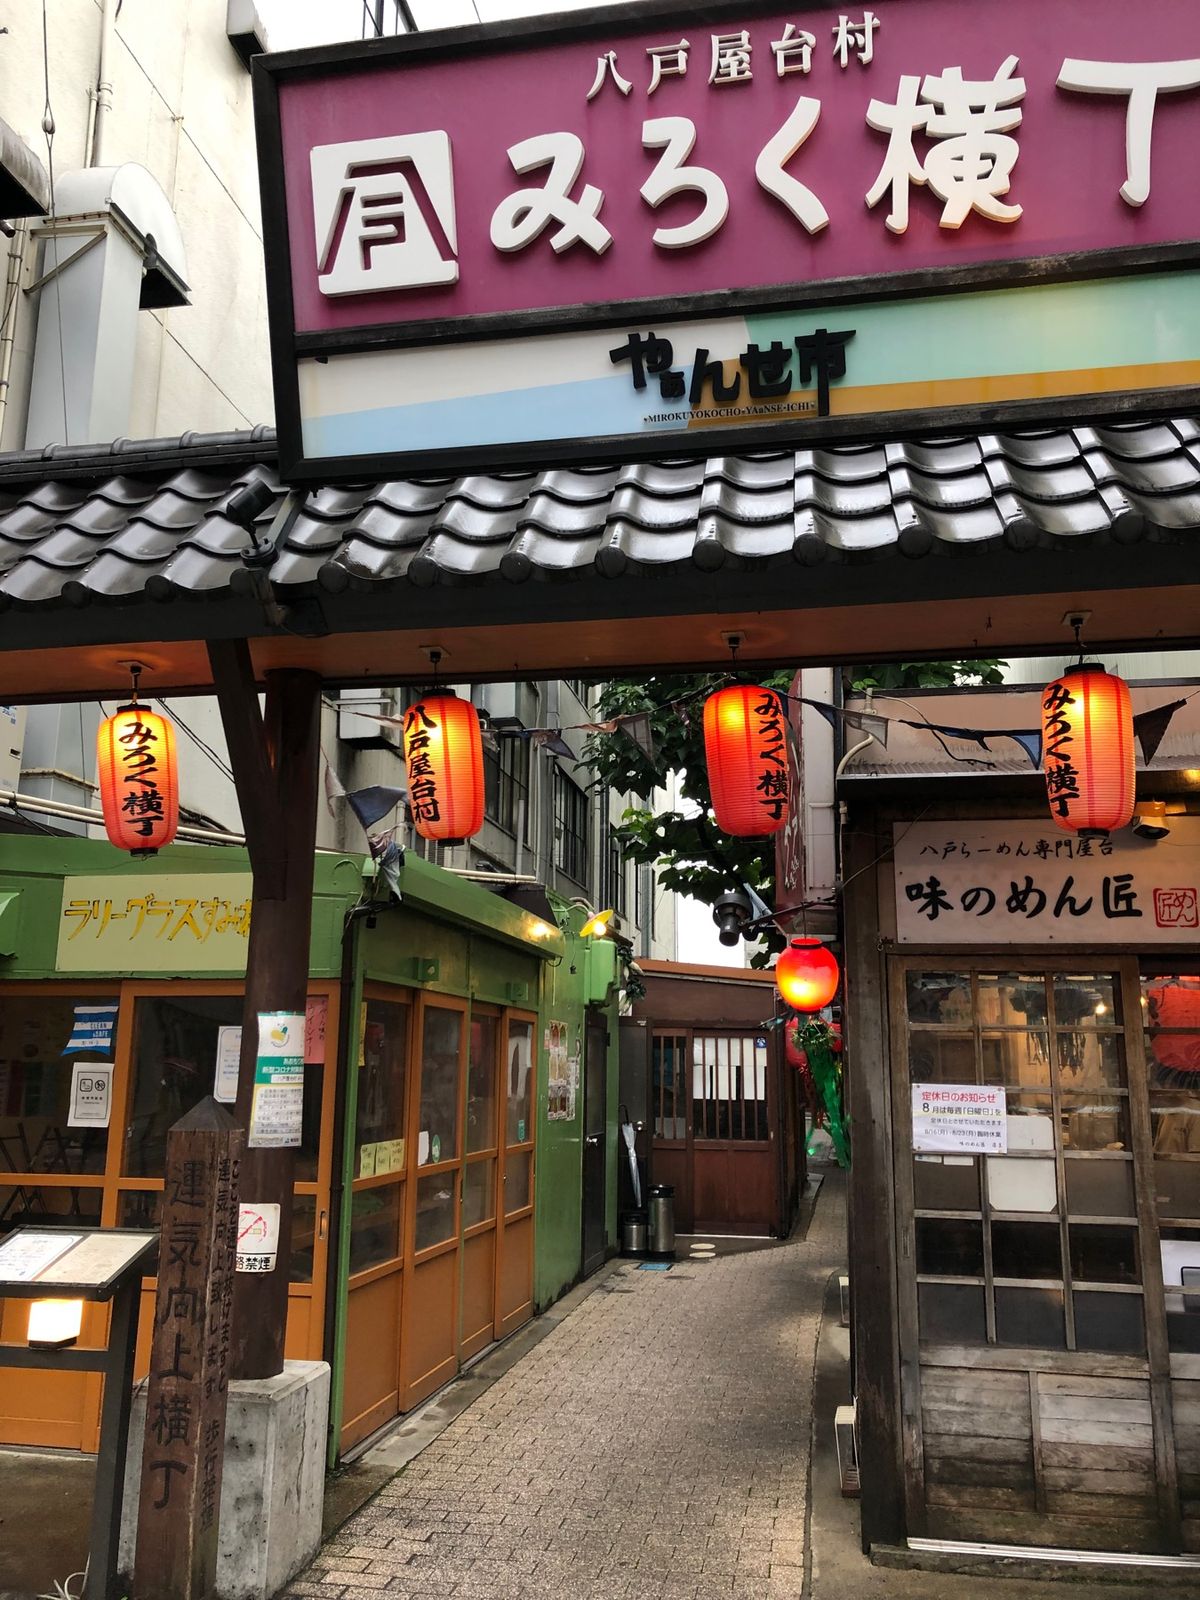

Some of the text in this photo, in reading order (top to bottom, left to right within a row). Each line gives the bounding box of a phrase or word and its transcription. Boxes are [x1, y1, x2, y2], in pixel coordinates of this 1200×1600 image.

[586, 11, 881, 101] 八戸屋台村
[490, 54, 1200, 255] みろく横丁
[119, 721, 164, 836] みろく横丁
[405, 705, 440, 823] 八戸屋台村
[754, 691, 789, 820] みろく横丁
[1043, 684, 1080, 817] みろく横丁
[905, 873, 1143, 921] 味のめん匠
[919, 839, 1115, 860] 八戸らーめん専門屋台
[922, 1091, 996, 1104] 定休日のお知らせ
[150, 1160, 206, 1510] 運気向上横丁
